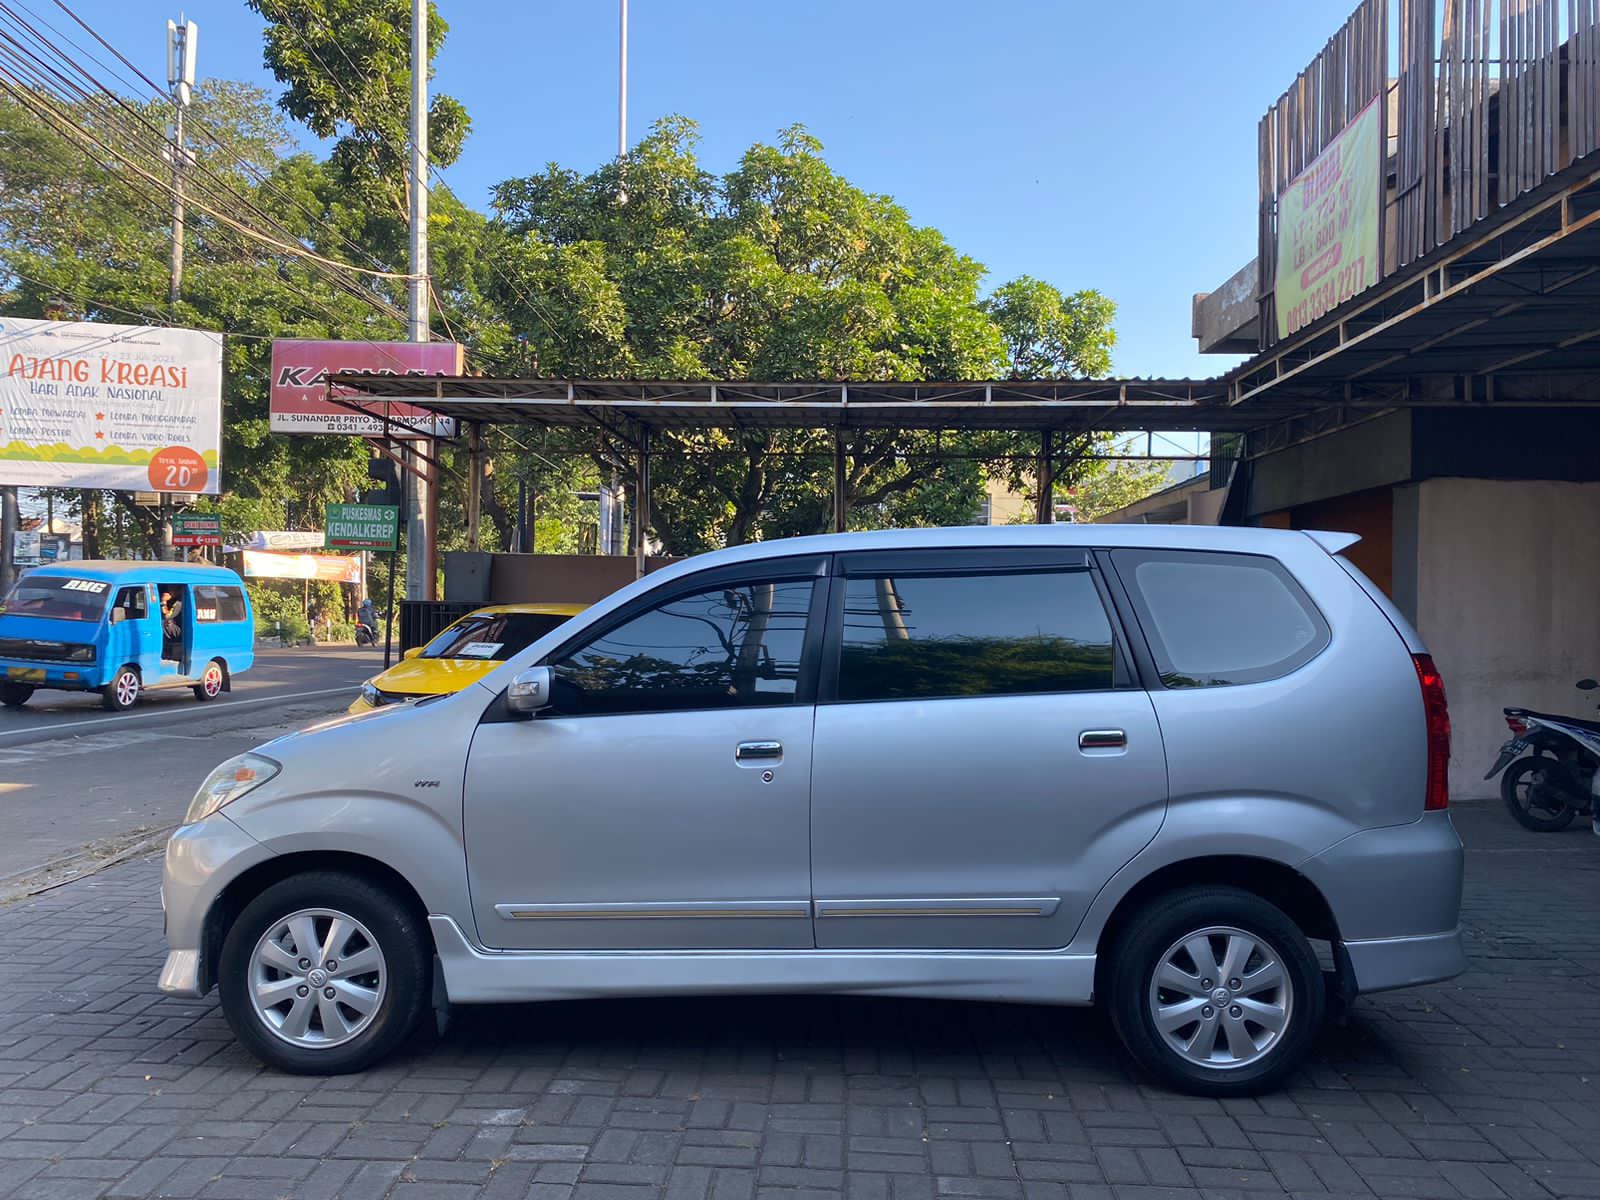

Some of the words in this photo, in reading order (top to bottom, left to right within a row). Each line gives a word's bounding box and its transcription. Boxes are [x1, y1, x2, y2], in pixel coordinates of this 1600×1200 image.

[8, 353, 89, 382] AJANG
[101, 358, 187, 388] KREASI
[30, 382, 58, 396] HARI
[65, 384, 99, 398] ANAK
[107, 386, 164, 401] NASIONAL
[110, 412, 138, 420] LOMBA
[277, 414, 289, 422] JL.
[291, 415, 340, 423] SUNANDAR
[344, 416, 370, 424] PRIYO
[337, 423, 357, 431] 0341
[367, 424, 399, 432] 49342
[110, 431, 138, 440] LOMBA
[165, 465, 191, 487] 20
[342, 507, 382, 521] PUSKESMAS
[327, 522, 394, 538] KENDALKEREP
